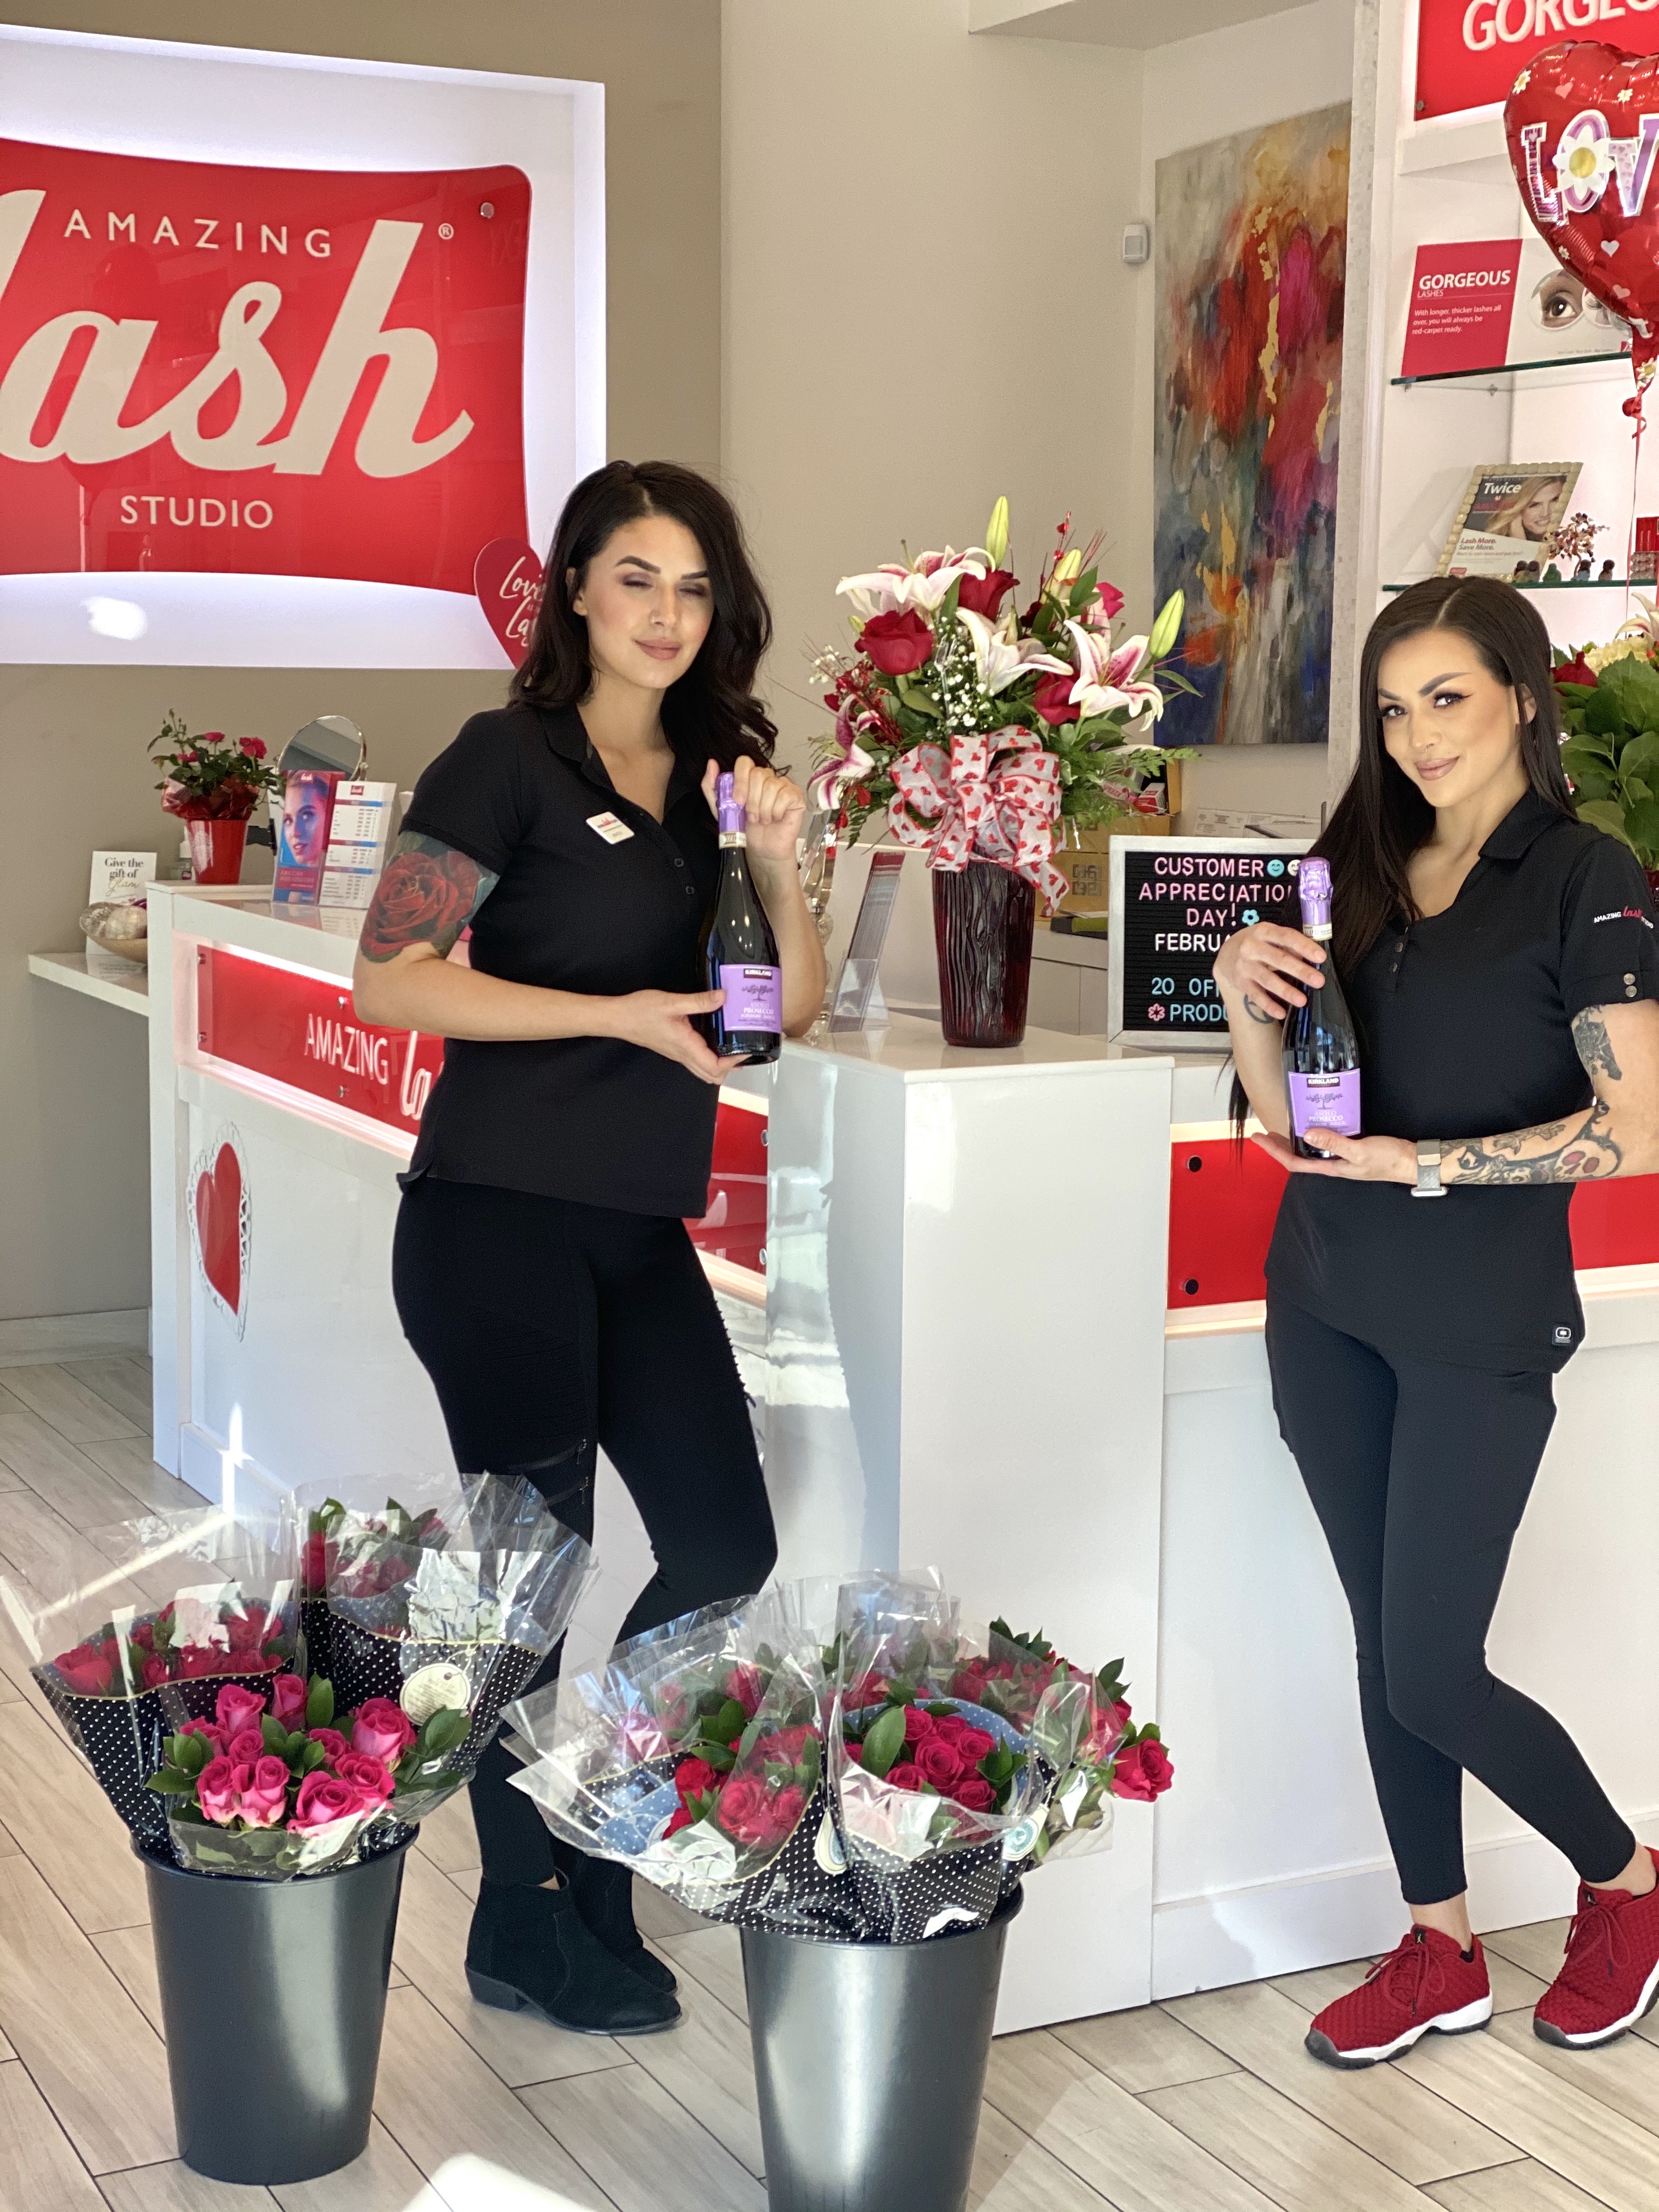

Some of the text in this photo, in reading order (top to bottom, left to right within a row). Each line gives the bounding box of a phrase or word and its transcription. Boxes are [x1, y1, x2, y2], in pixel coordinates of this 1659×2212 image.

[1463, 0, 1659, 51] GORG
[64, 208, 330, 258] AMAZING
[1419, 269, 1511, 290] GORGEOUS
[1417, 289, 1443, 298] LASHES
[1453, 315, 1473, 324] always
[0, 189, 474, 477] ash
[1444, 325, 1462, 334] ready.
[1484, 482, 1522, 494] Twice
[120, 494, 273, 529] STUDIO
[105, 857, 144, 868] Give the
[1154, 856, 1264, 878] CUSTOMER
[109, 868, 139, 879] gift of
[1187, 903, 1236, 927] DAY!
[1594, 911, 1622, 923] AMAZING
[1152, 977, 1175, 995] 20
[304, 1013, 444, 1121] AMAZING la
